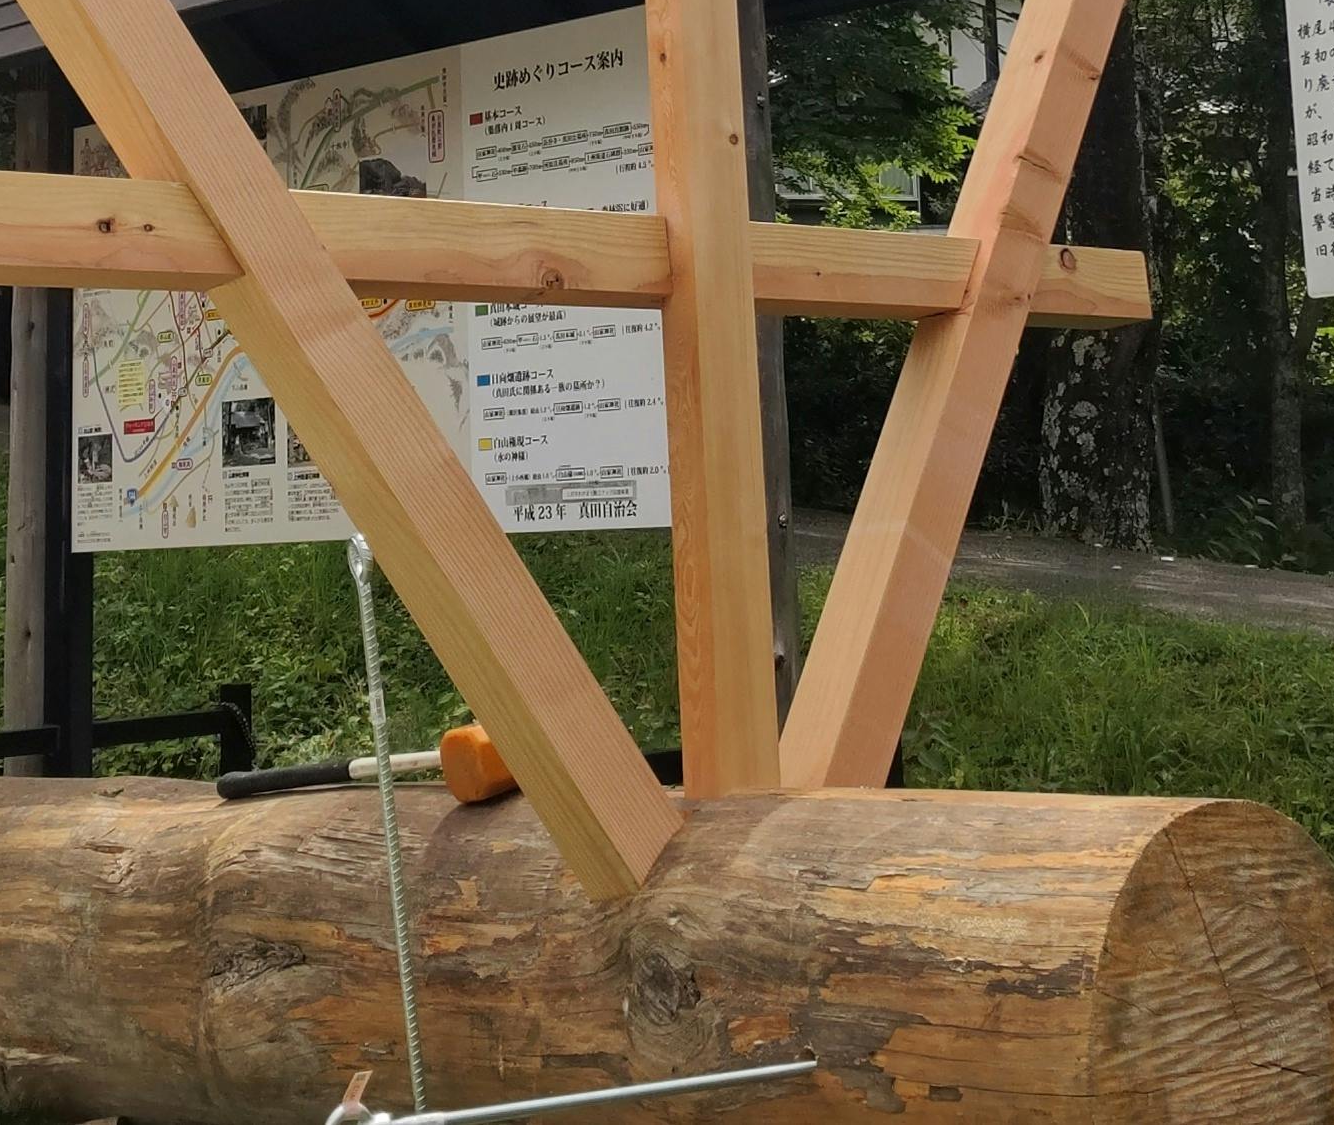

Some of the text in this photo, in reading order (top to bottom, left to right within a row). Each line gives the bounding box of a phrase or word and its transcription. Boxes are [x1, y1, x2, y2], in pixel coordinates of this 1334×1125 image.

[492, 48, 624, 92] 史跡めぐりコース案内
[484, 105, 523, 121] 基本コース
[491, 368, 555, 385] 日向畑遺跡コース
[493, 434, 549, 450] 白山権現コース
[578, 500, 638, 520] 真田自治会
